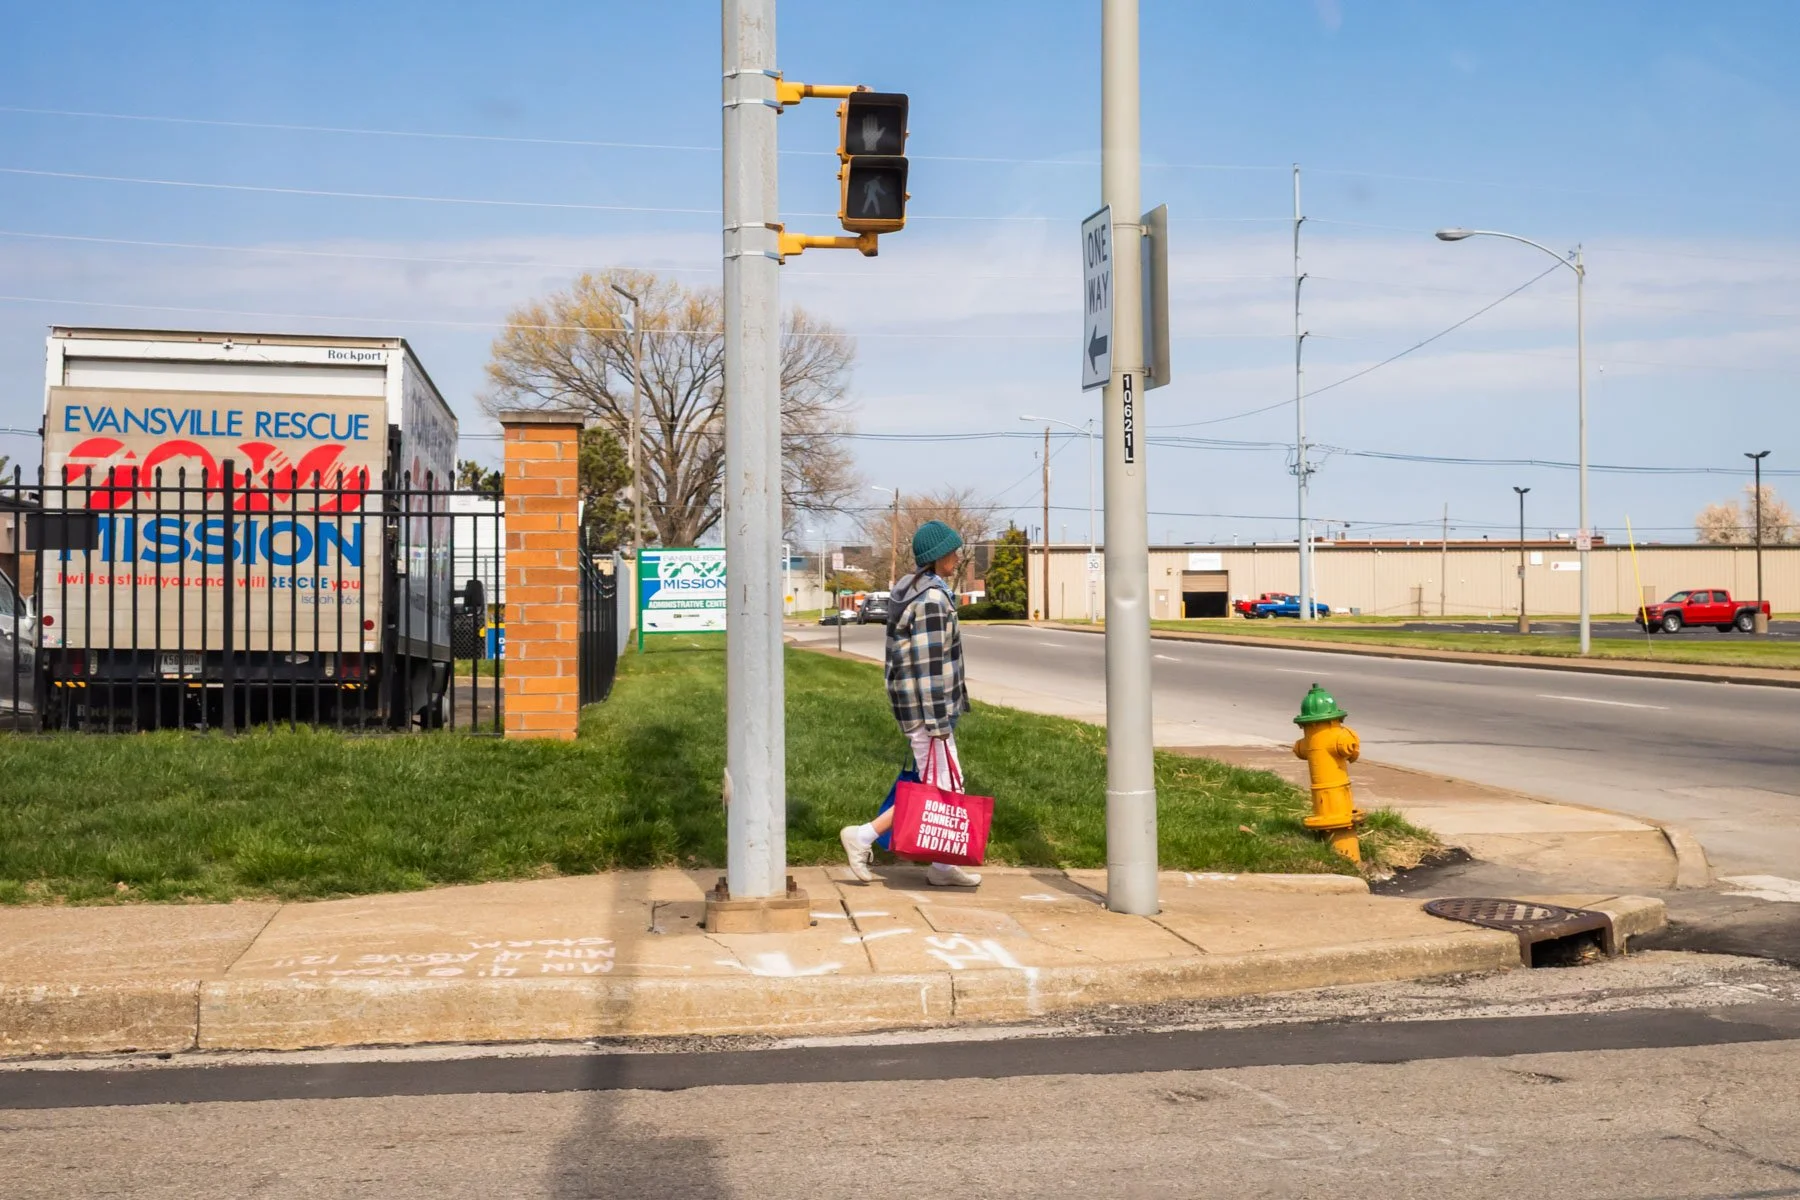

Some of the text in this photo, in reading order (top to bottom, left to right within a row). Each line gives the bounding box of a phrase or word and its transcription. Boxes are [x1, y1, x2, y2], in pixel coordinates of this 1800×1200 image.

[1088, 223, 1108, 268] ONE
[1088, 271, 1109, 315] WAY
[327, 349, 381, 362] Rockport
[64, 405, 369, 441] EVANSVILLE RESCUE
[65, 572, 94, 585] wil
[330, 580, 361, 591] you
[663, 579, 727, 589] MISSION
[302, 595, 362, 605] Isaah 6:4
[705, 600, 727, 608] CENTE
[921, 810, 970, 834] CONNECT of
[919, 823, 970, 843] SOUTHWEST
[916, 833, 968, 856] INDIANA
